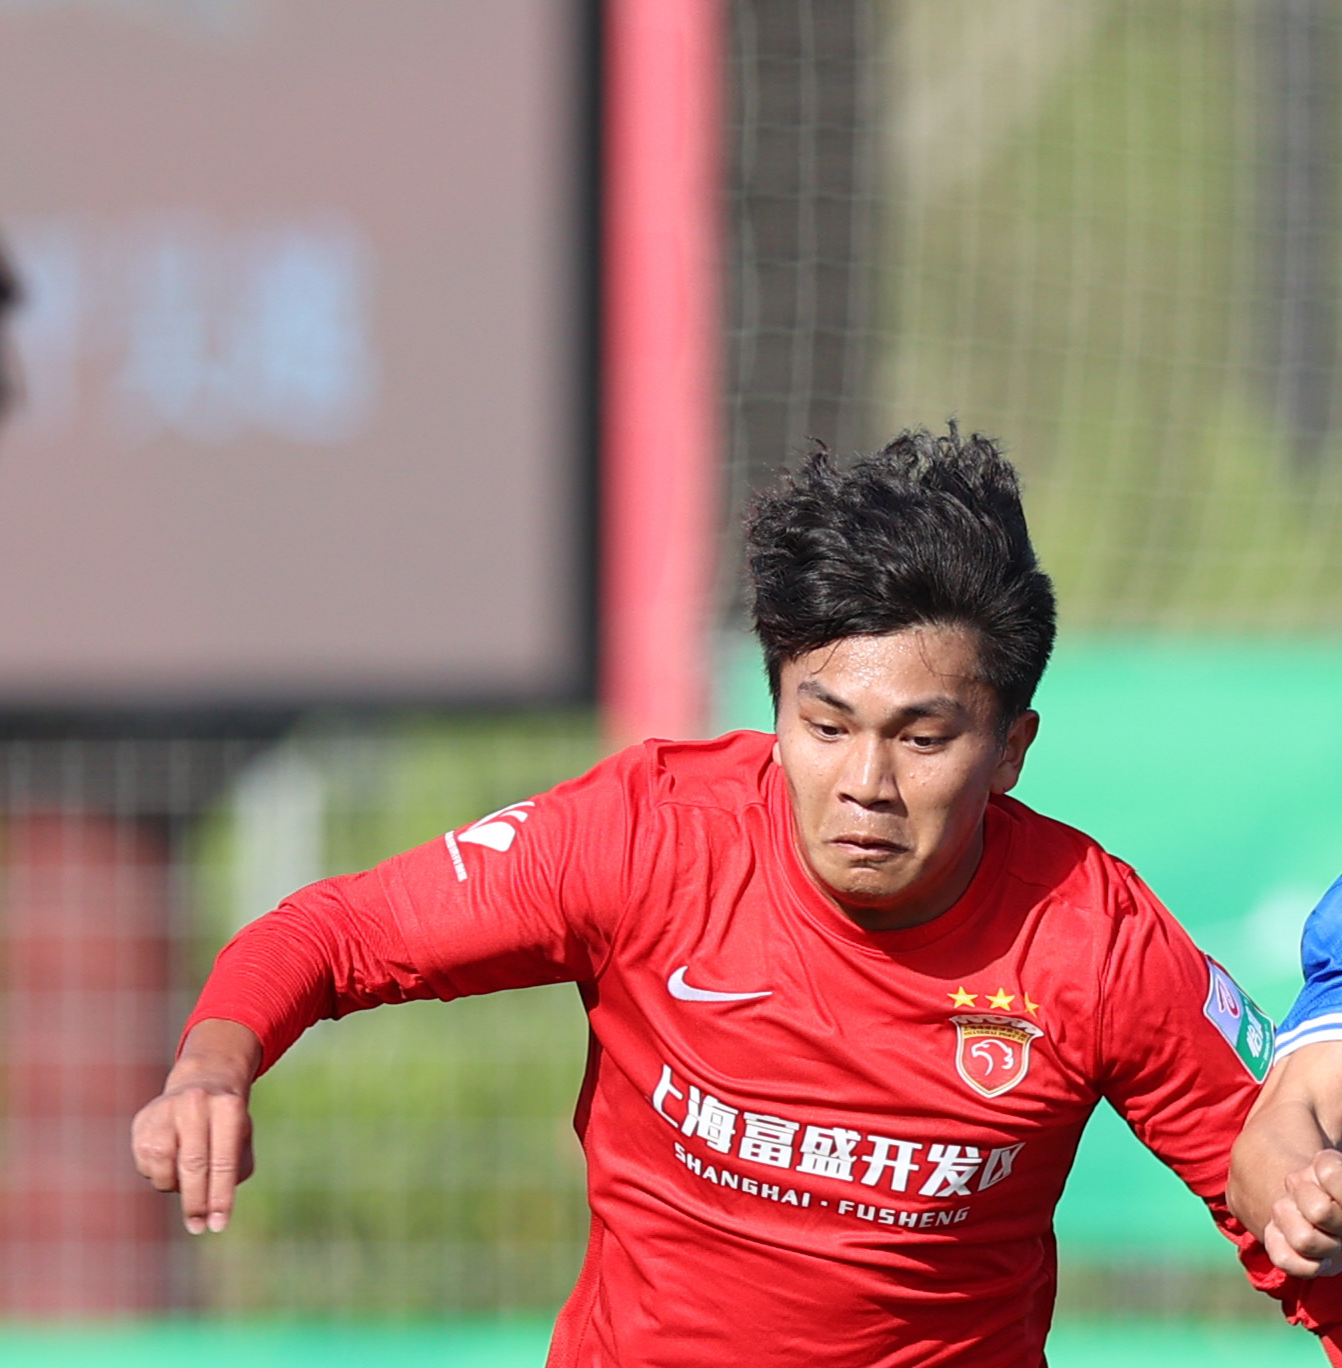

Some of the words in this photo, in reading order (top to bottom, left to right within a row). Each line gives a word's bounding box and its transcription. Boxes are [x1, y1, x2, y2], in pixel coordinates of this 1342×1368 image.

[653, 1064, 1026, 1197] 上海富盛开发区
[674, 1142, 811, 1207] SHANGHAI
[838, 1199, 971, 1228] FUSHENG
